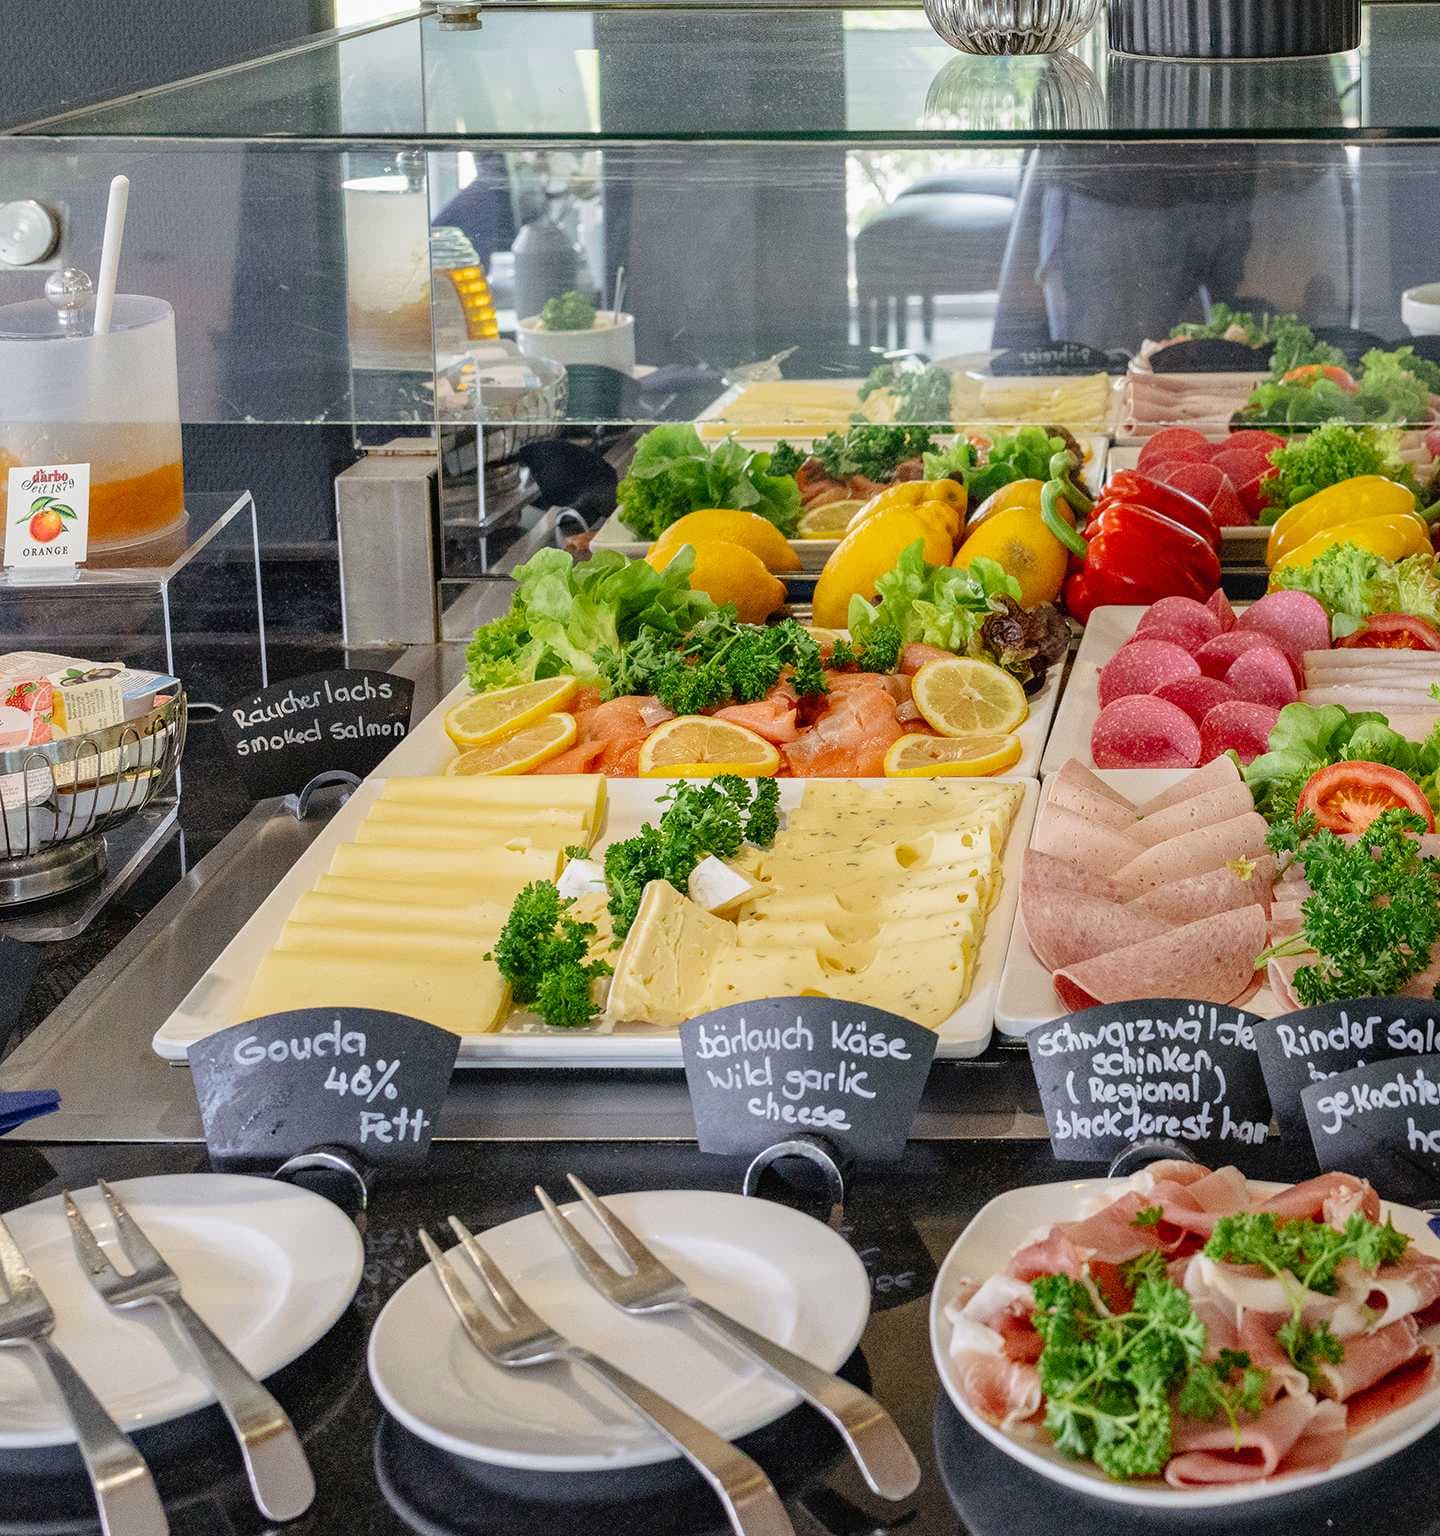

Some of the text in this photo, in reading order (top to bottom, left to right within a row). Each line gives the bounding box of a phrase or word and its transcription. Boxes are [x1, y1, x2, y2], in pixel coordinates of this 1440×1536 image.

[51, 478, 75, 494] 1879
[22, 546, 69, 557] ORANGE
[233, 1020, 367, 1065] Gouda
[1037, 1005, 1257, 1057] schwarzwälde
[1276, 1010, 1382, 1058] Rinder
[324, 1059, 401, 1103] 48%
[707, 1056, 876, 1101] wild garlic
[359, 1107, 430, 1144] Fett
[747, 1091, 851, 1130] cheese
[1055, 1108, 1122, 1140] black
